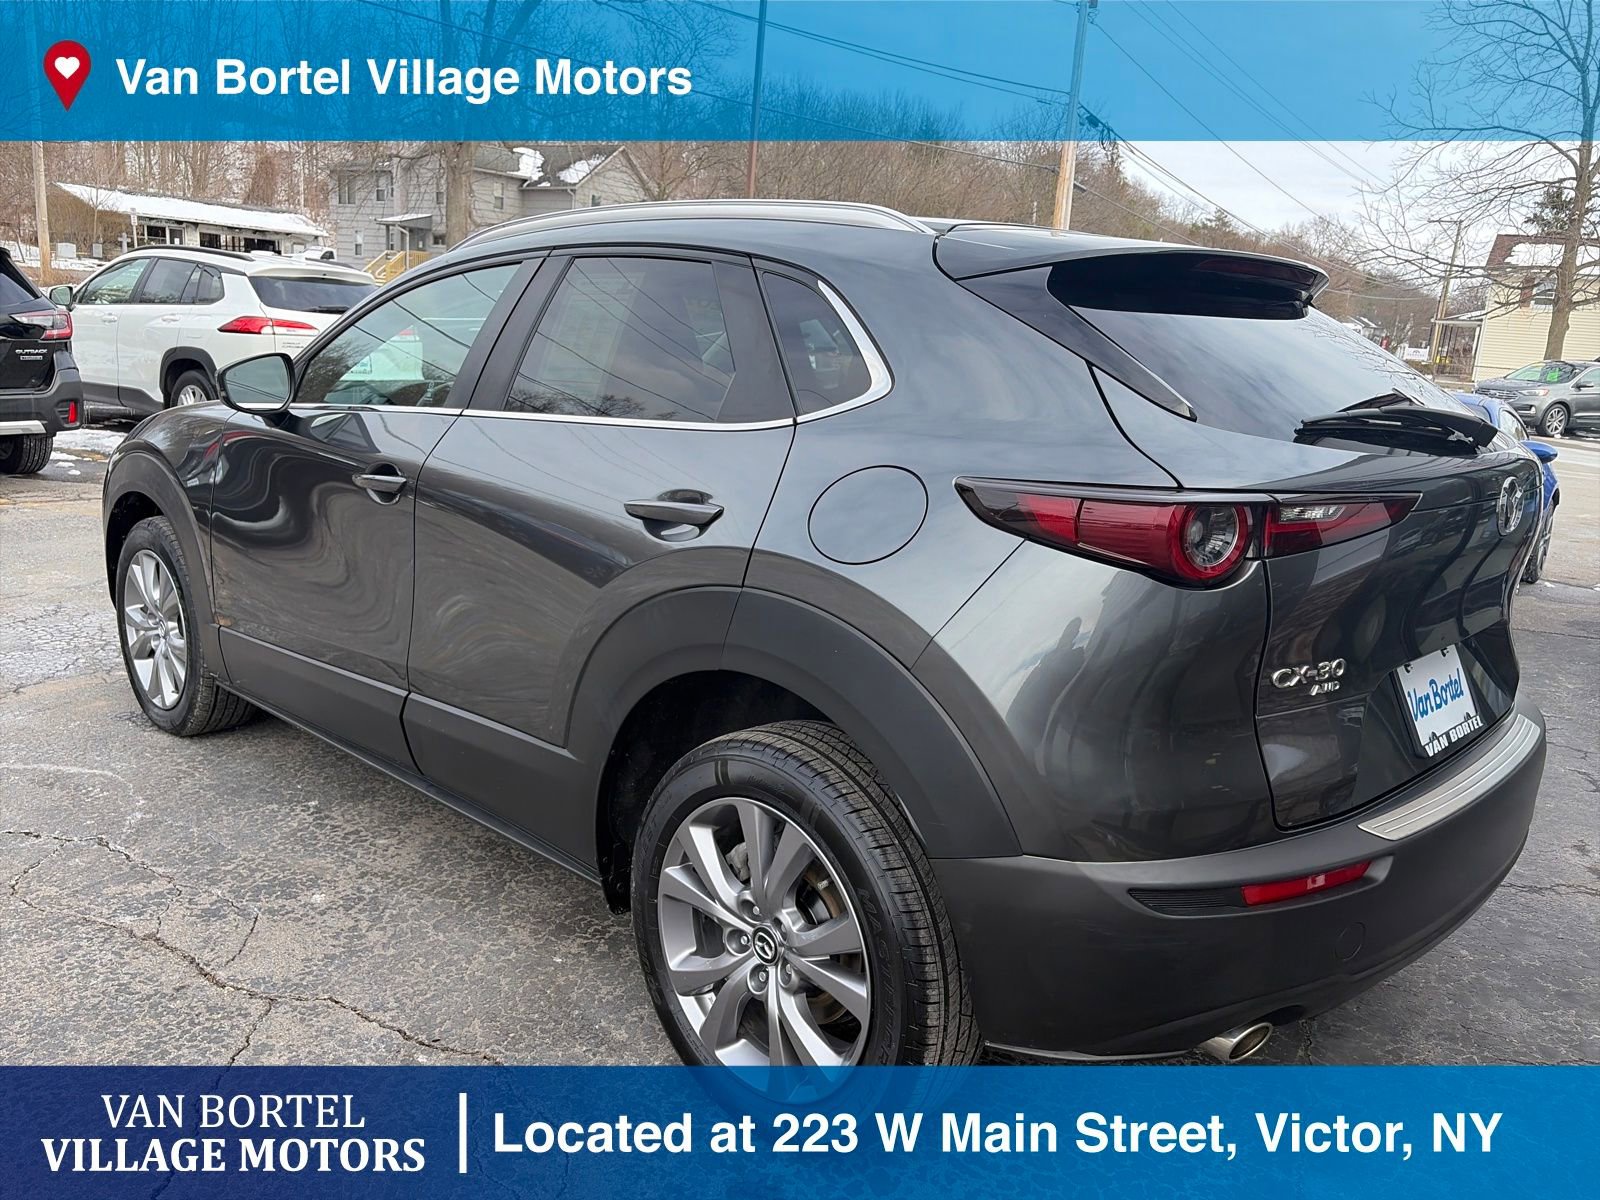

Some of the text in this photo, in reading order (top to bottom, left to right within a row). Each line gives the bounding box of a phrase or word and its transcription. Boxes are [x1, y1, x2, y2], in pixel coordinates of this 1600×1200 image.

[1272, 657, 1346, 688] CX-30
[1407, 667, 1464, 722] Van Bortel
[1424, 714, 1484, 757] VAN BORTEL
